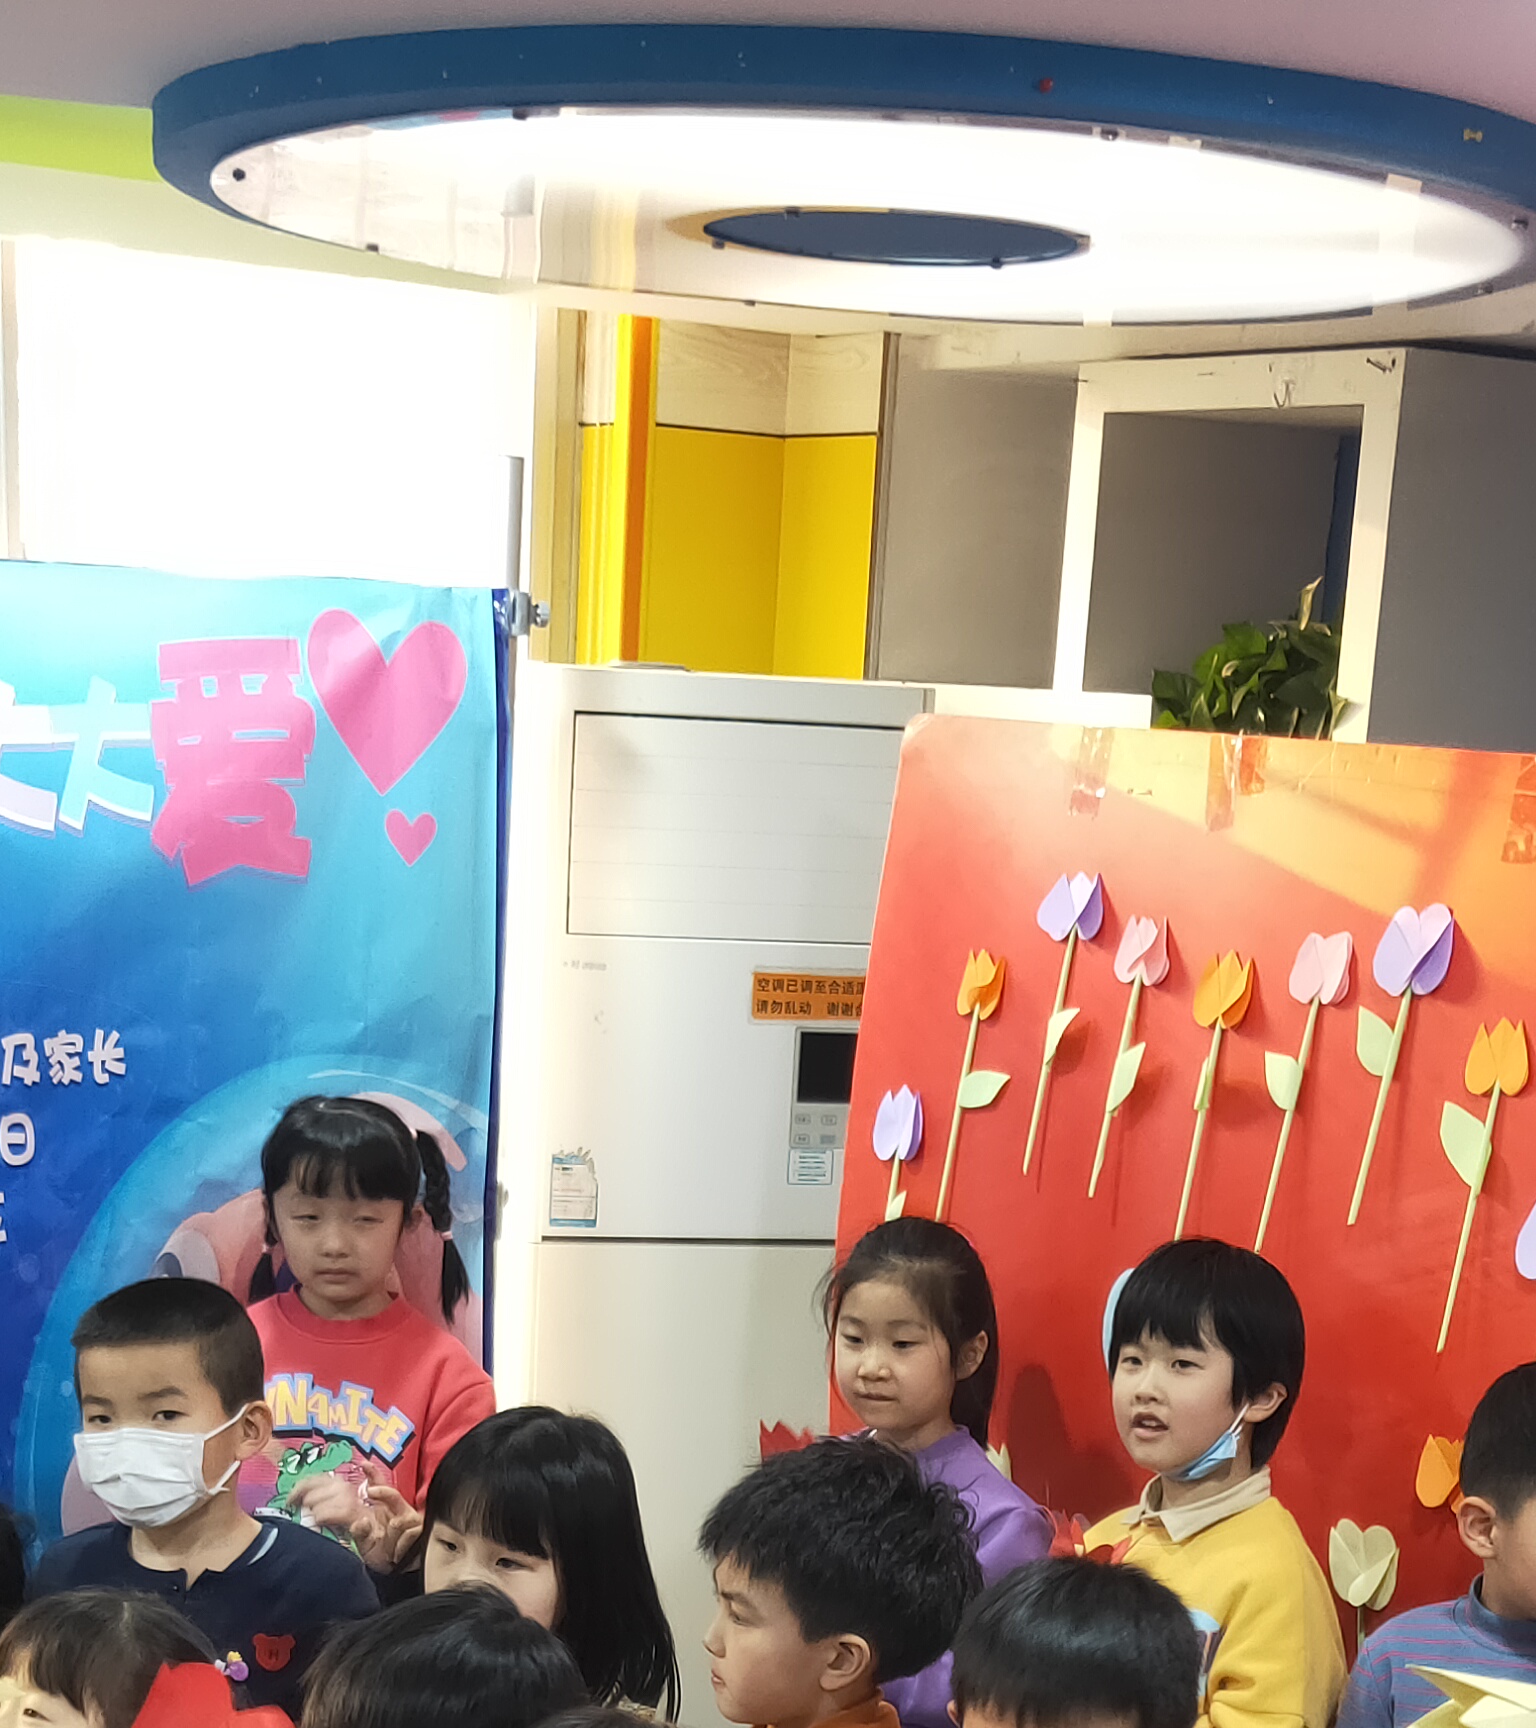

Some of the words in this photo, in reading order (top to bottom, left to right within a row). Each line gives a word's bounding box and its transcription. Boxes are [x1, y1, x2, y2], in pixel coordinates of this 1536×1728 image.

[756, 998, 812, 1015] 请勿乱动
[265, 1376, 411, 1458] NAMITE
